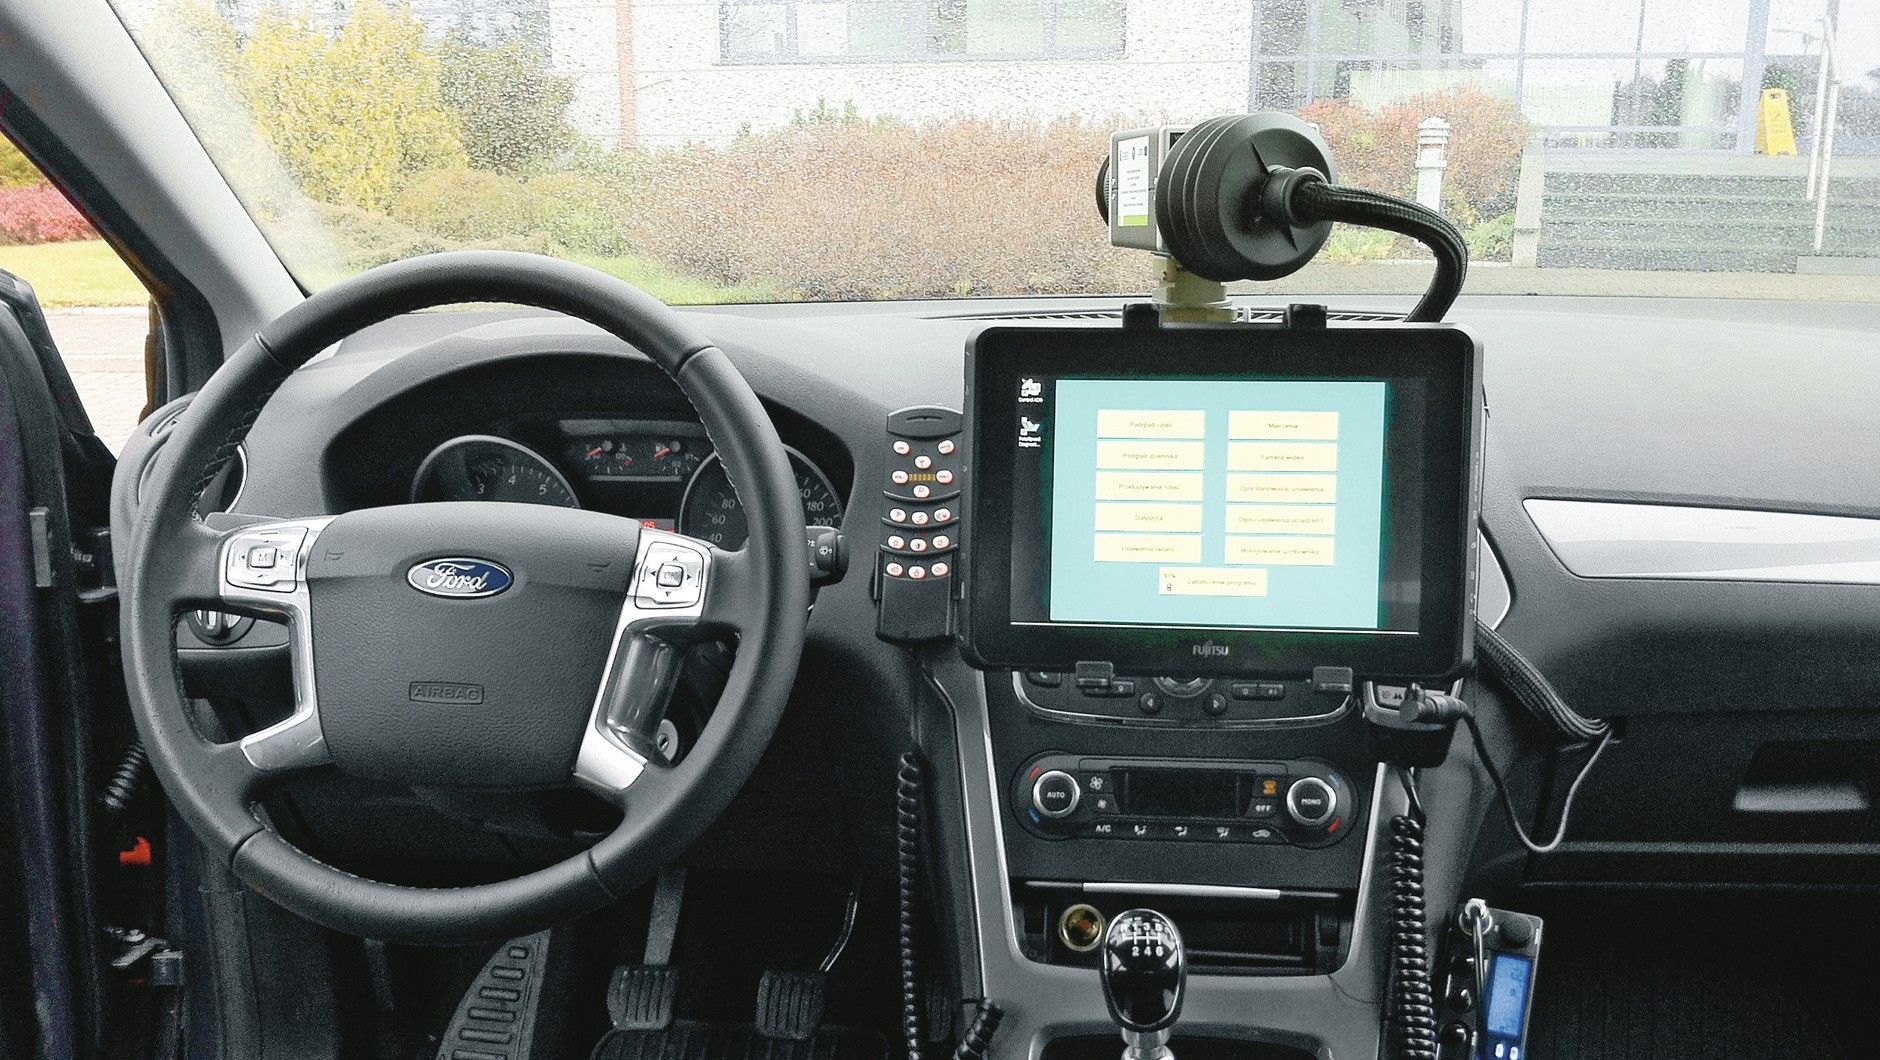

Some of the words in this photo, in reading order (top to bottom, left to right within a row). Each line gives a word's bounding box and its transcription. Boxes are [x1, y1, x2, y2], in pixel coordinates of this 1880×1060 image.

[425, 562, 489, 593] Ford
[1192, 640, 1229, 657] FUJITSU
[413, 685, 481, 701] AIRBAG
[1046, 791, 1066, 799] AUTO
[1301, 798, 1322, 806] MONO
[1095, 824, 1112, 833] A/C
[1143, 922, 1151, 931] 3
[1132, 946, 1140, 957] 2
[1144, 946, 1152, 957] 4
[1155, 946, 1164, 957] 6
